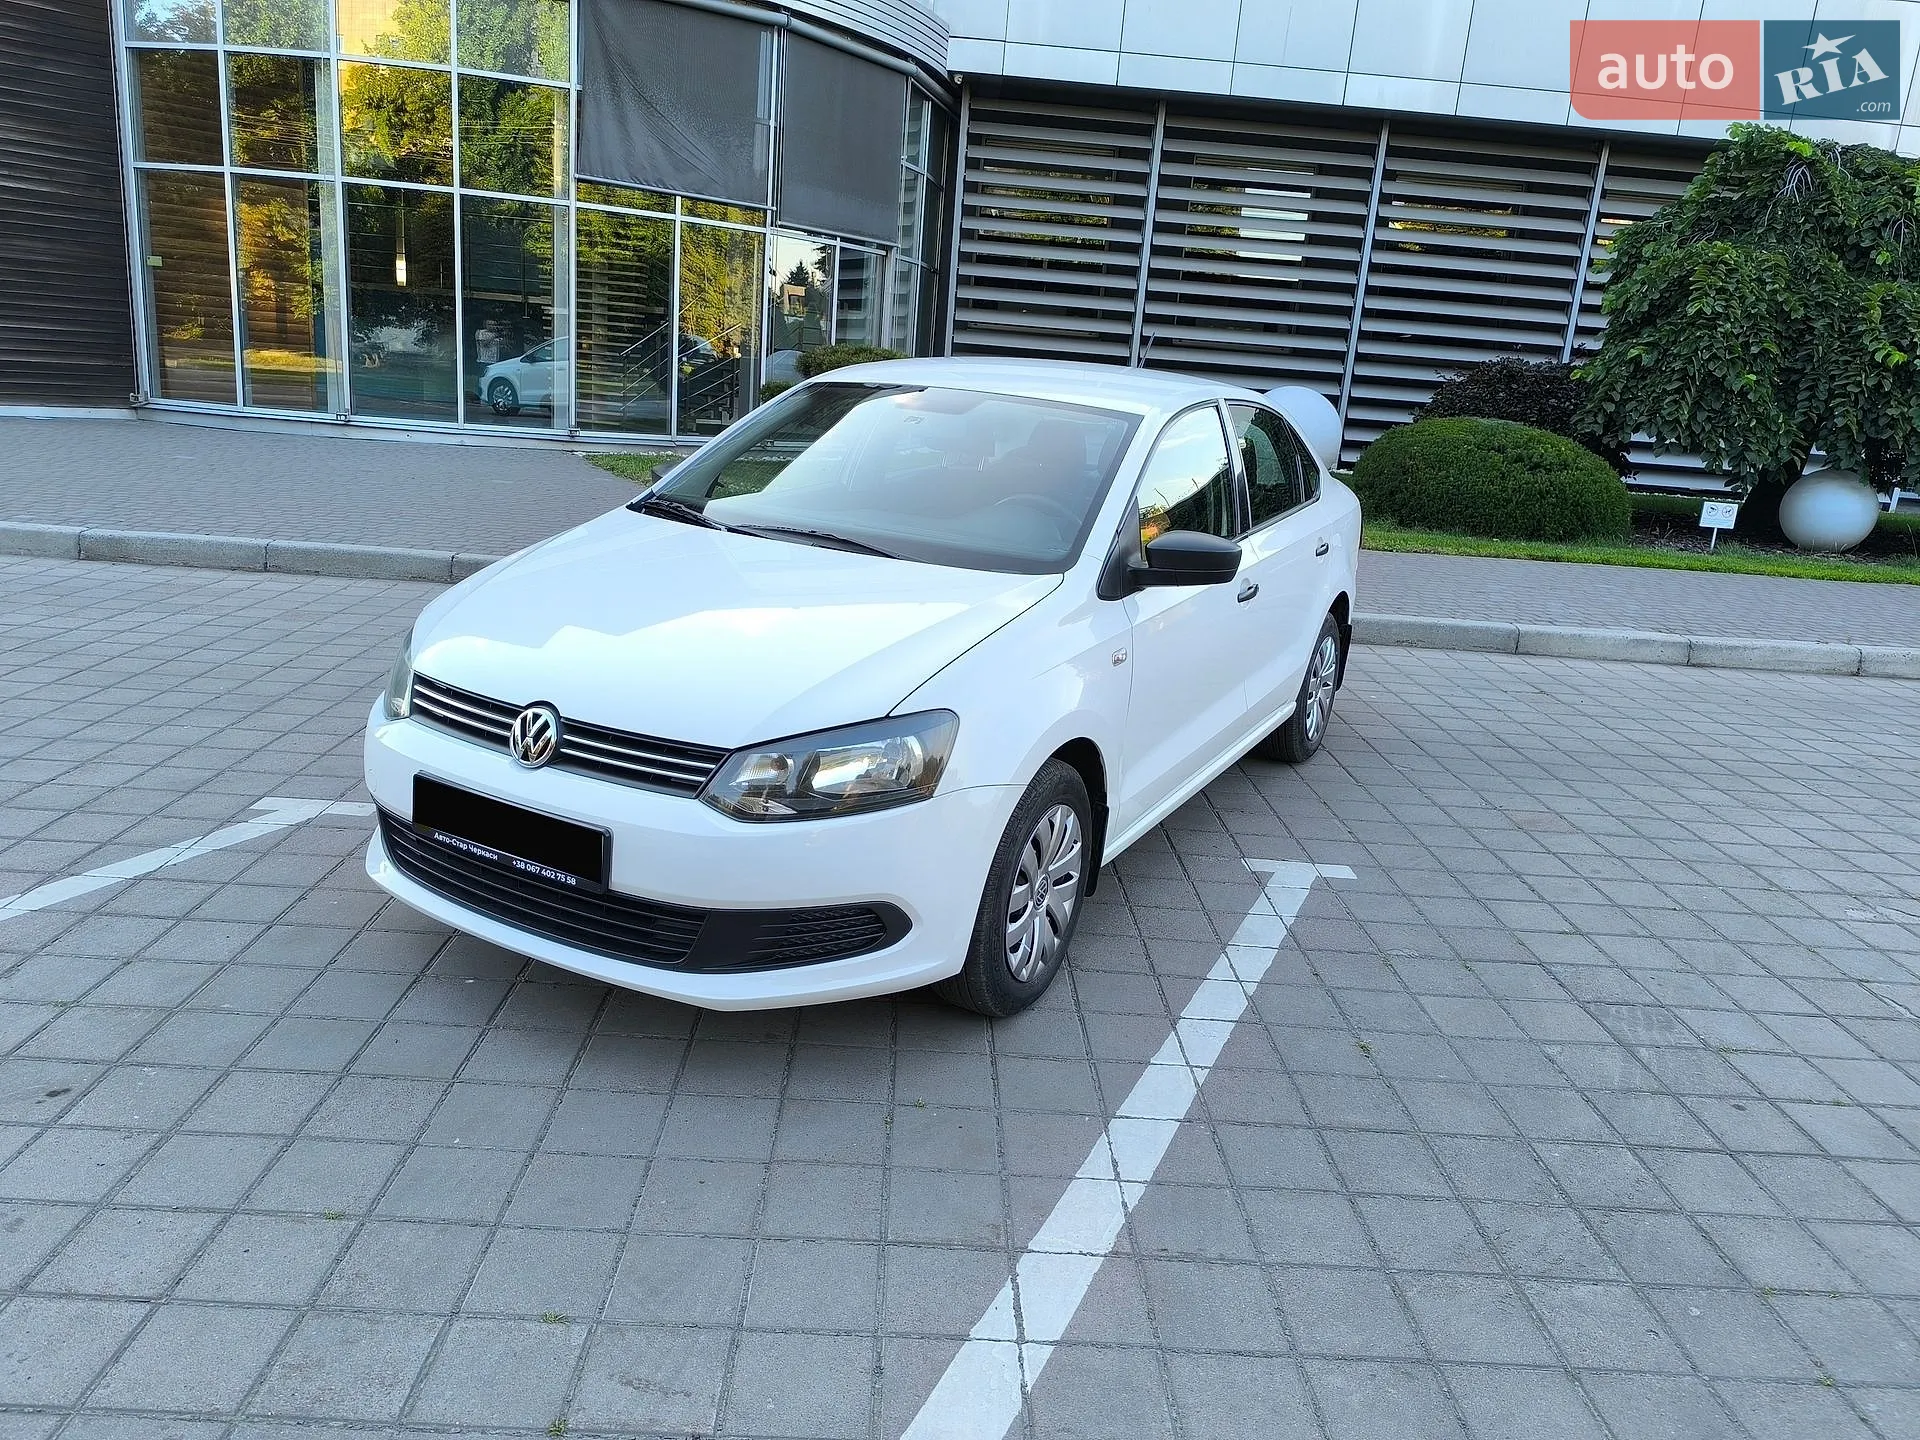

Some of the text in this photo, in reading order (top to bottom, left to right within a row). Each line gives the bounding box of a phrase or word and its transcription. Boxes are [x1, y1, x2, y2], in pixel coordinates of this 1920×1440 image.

[434, 832, 577, 886] Авто-Стар Черкаси +38 067 402 75 58
